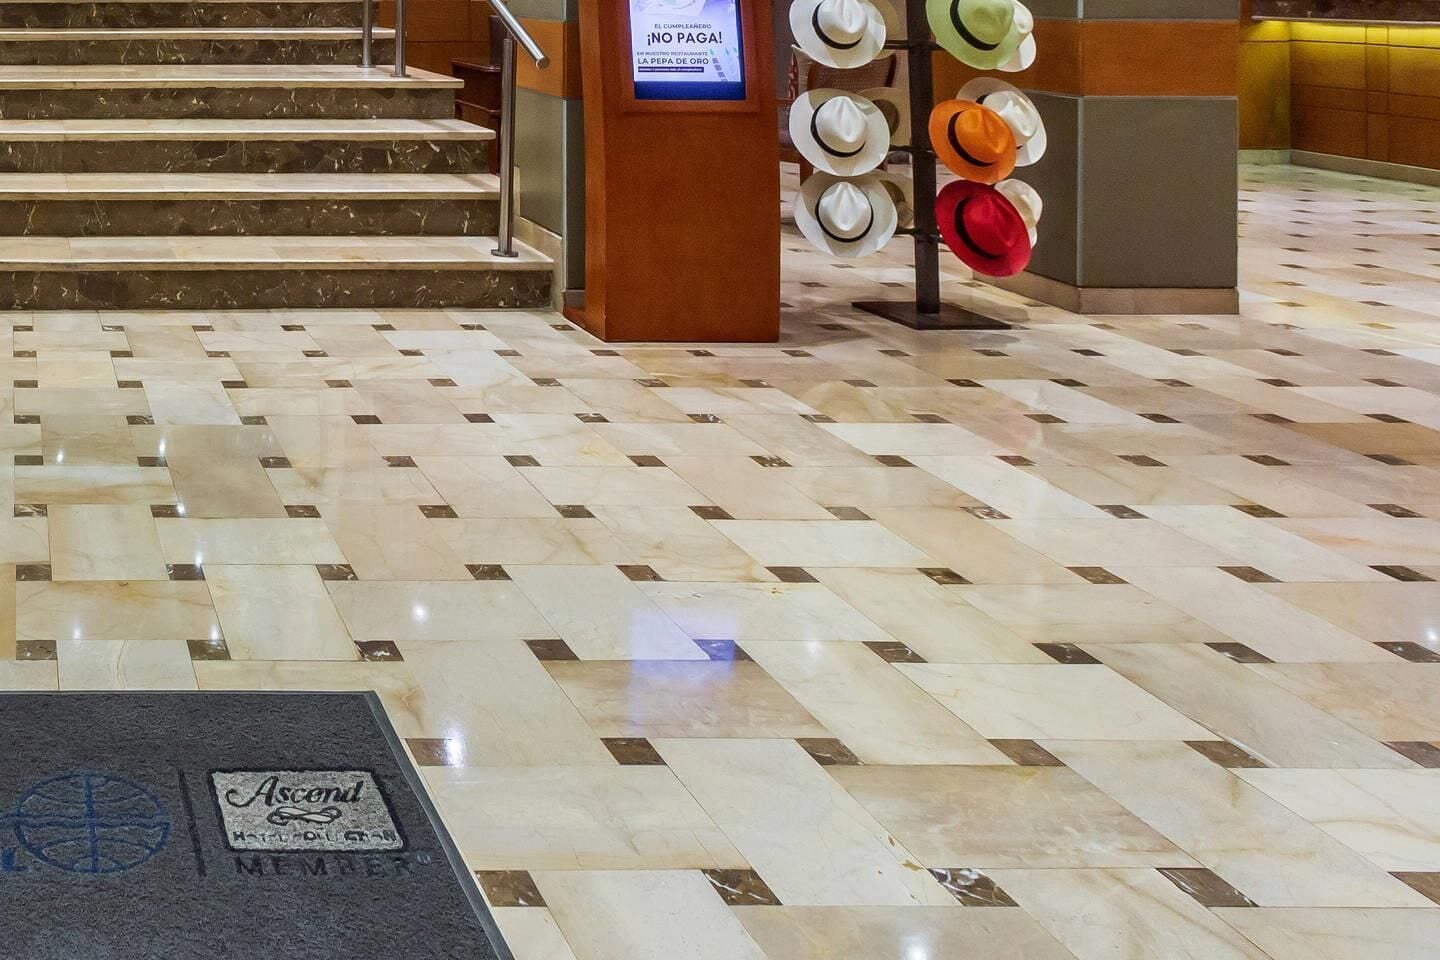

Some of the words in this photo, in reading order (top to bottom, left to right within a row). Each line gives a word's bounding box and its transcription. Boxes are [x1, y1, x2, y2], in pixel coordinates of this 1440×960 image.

[647, 32, 673, 46] ¡NO
[677, 32, 723, 44] PAGA!
[225, 776, 364, 808] Ascend
